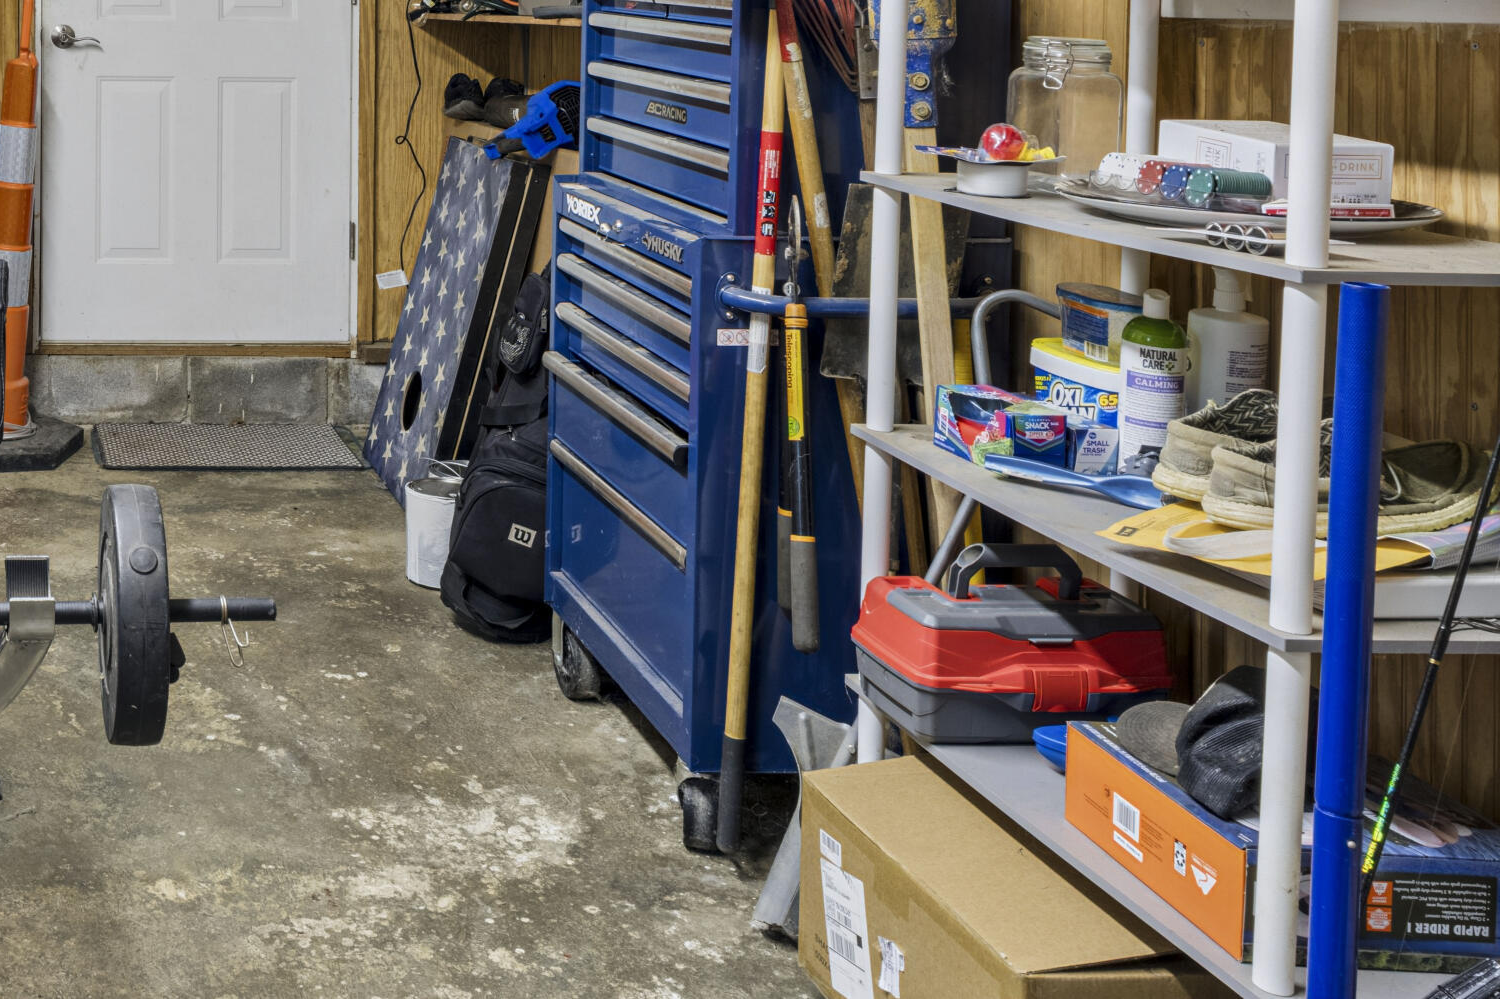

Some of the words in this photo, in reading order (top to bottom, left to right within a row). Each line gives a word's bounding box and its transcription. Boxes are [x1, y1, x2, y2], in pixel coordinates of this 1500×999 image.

[662, 105, 687, 122] RACING
[1339, 162, 1375, 172] DRINK
[566, 193, 601, 225] VORTEX
[651, 236, 683, 263] HUSKY
[1139, 347, 1178, 362] NATURAL
[1142, 359, 1166, 371] CARE
[1135, 377, 1179, 389] CALMING
[1052, 381, 1082, 407] OXI
[1099, 394, 1118, 406] 65
[1025, 421, 1050, 430] SNACK
[1415, 922, 1450, 935] RIDER
[1454, 923, 1489, 937] RAPID
